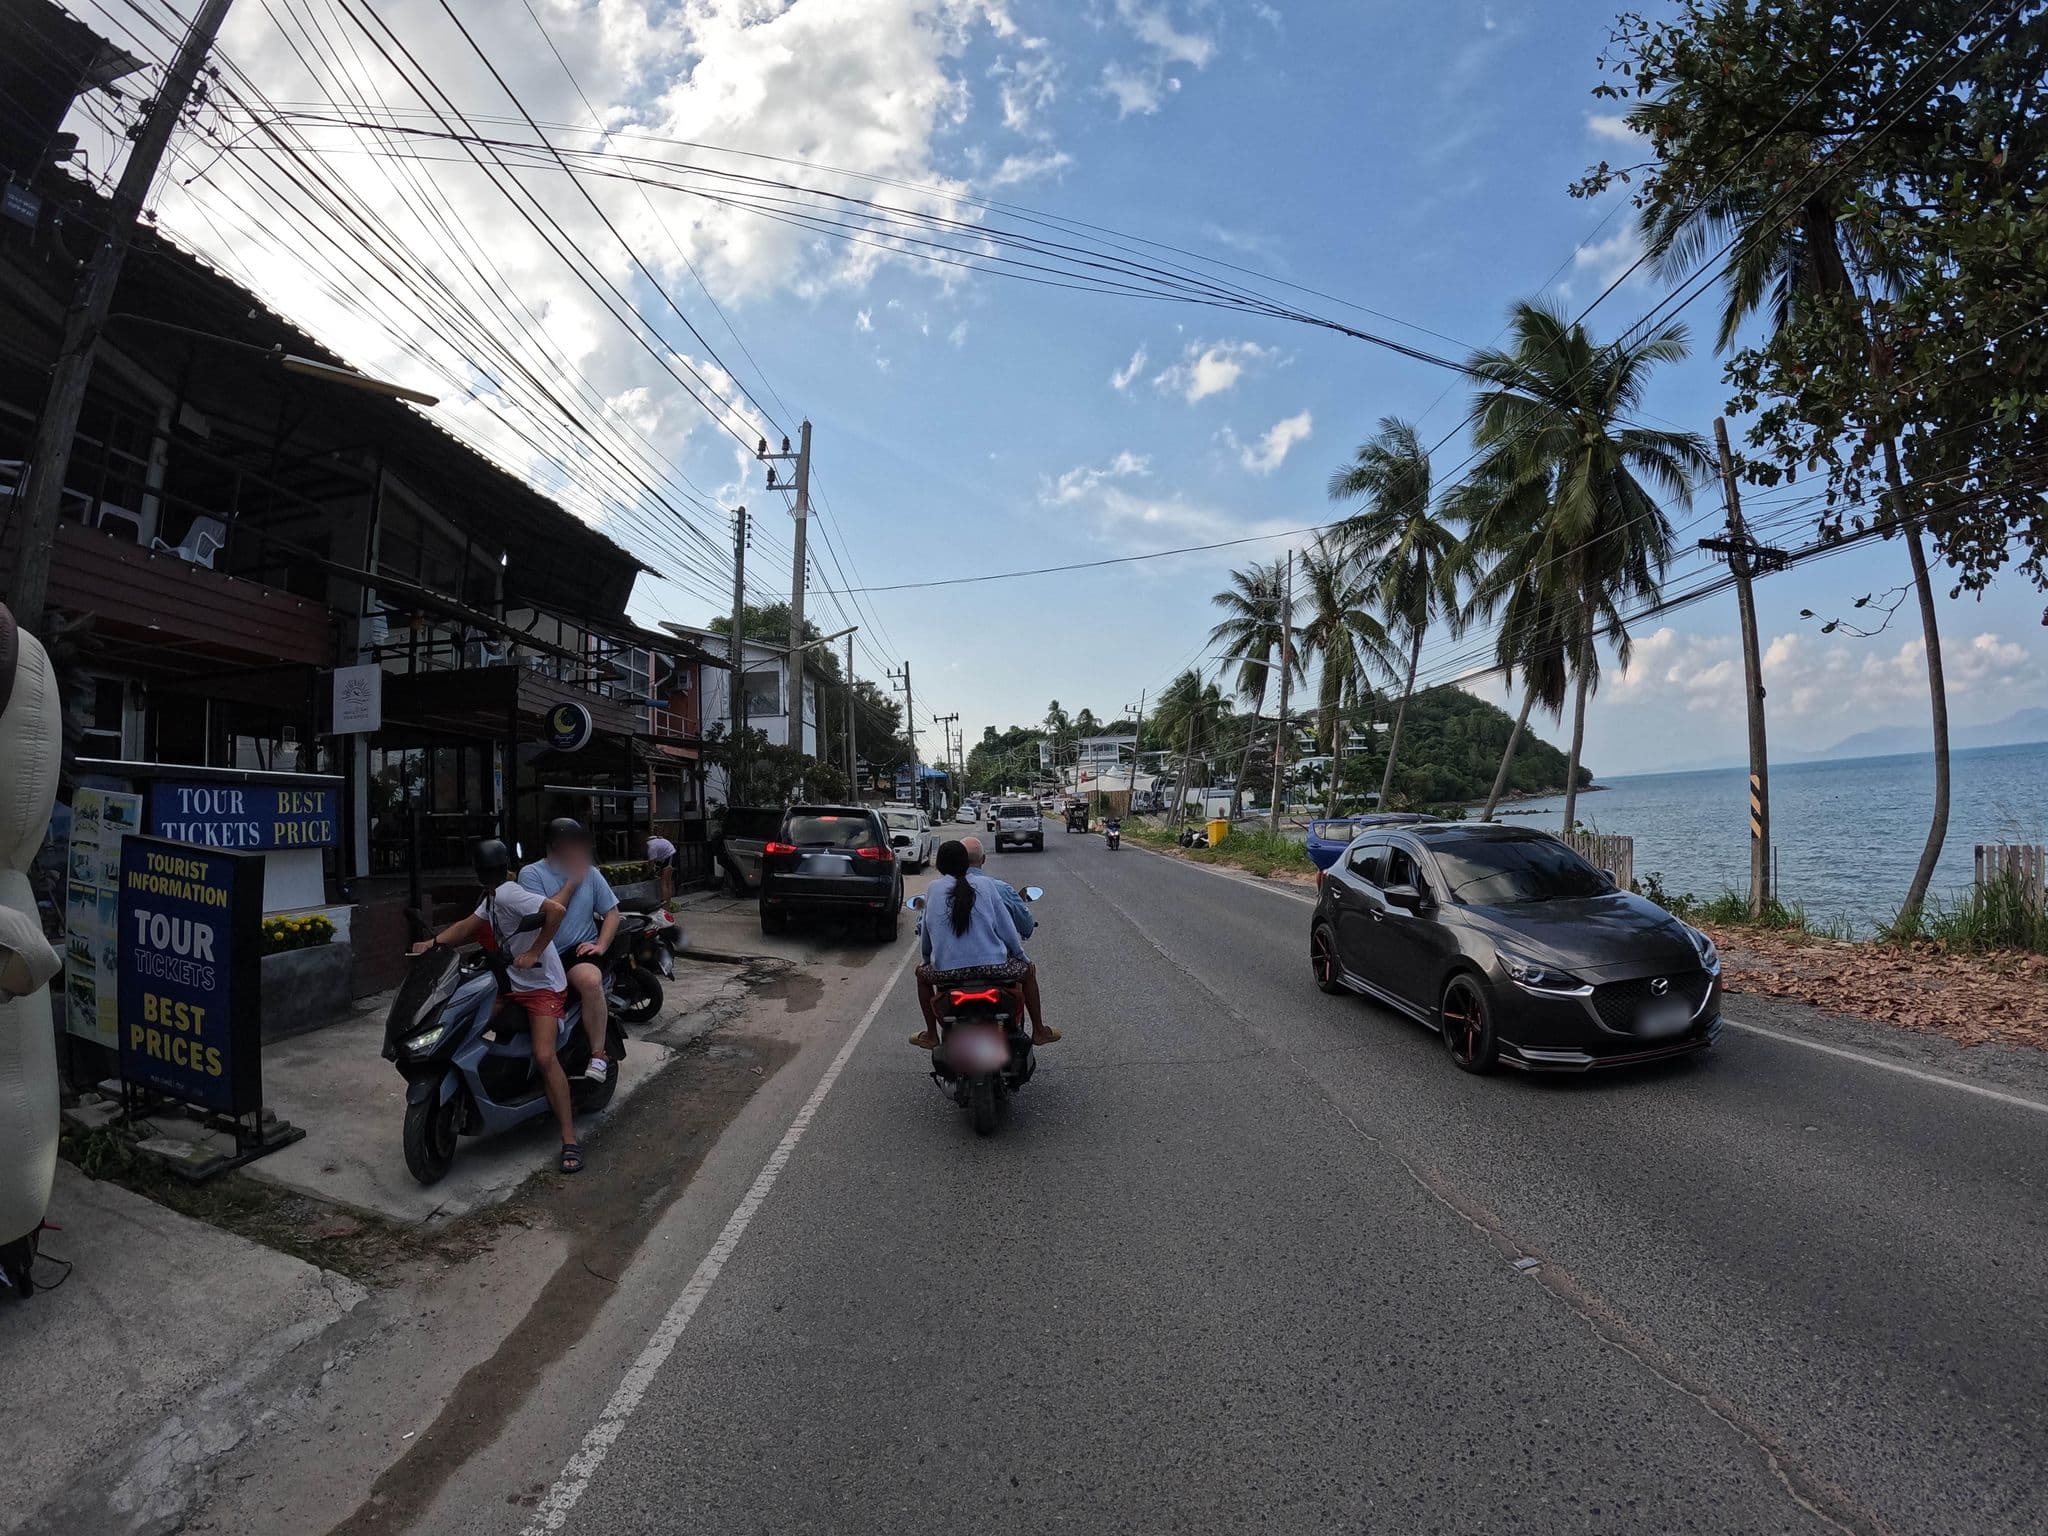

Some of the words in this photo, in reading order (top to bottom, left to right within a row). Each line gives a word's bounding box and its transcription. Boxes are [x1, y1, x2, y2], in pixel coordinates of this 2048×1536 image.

[178, 787, 245, 815] TOUR
[277, 791, 326, 814] BEST
[161, 821, 260, 848] TICKETS
[273, 819, 331, 845] PRICE
[146, 852, 209, 883] TOURIST
[128, 873, 228, 908] INFORMATION
[134, 909, 216, 963] TOUR
[134, 949, 217, 992] TICKETS
[143, 992, 206, 1037] BEST
[130, 1024, 224, 1078] PRICES
